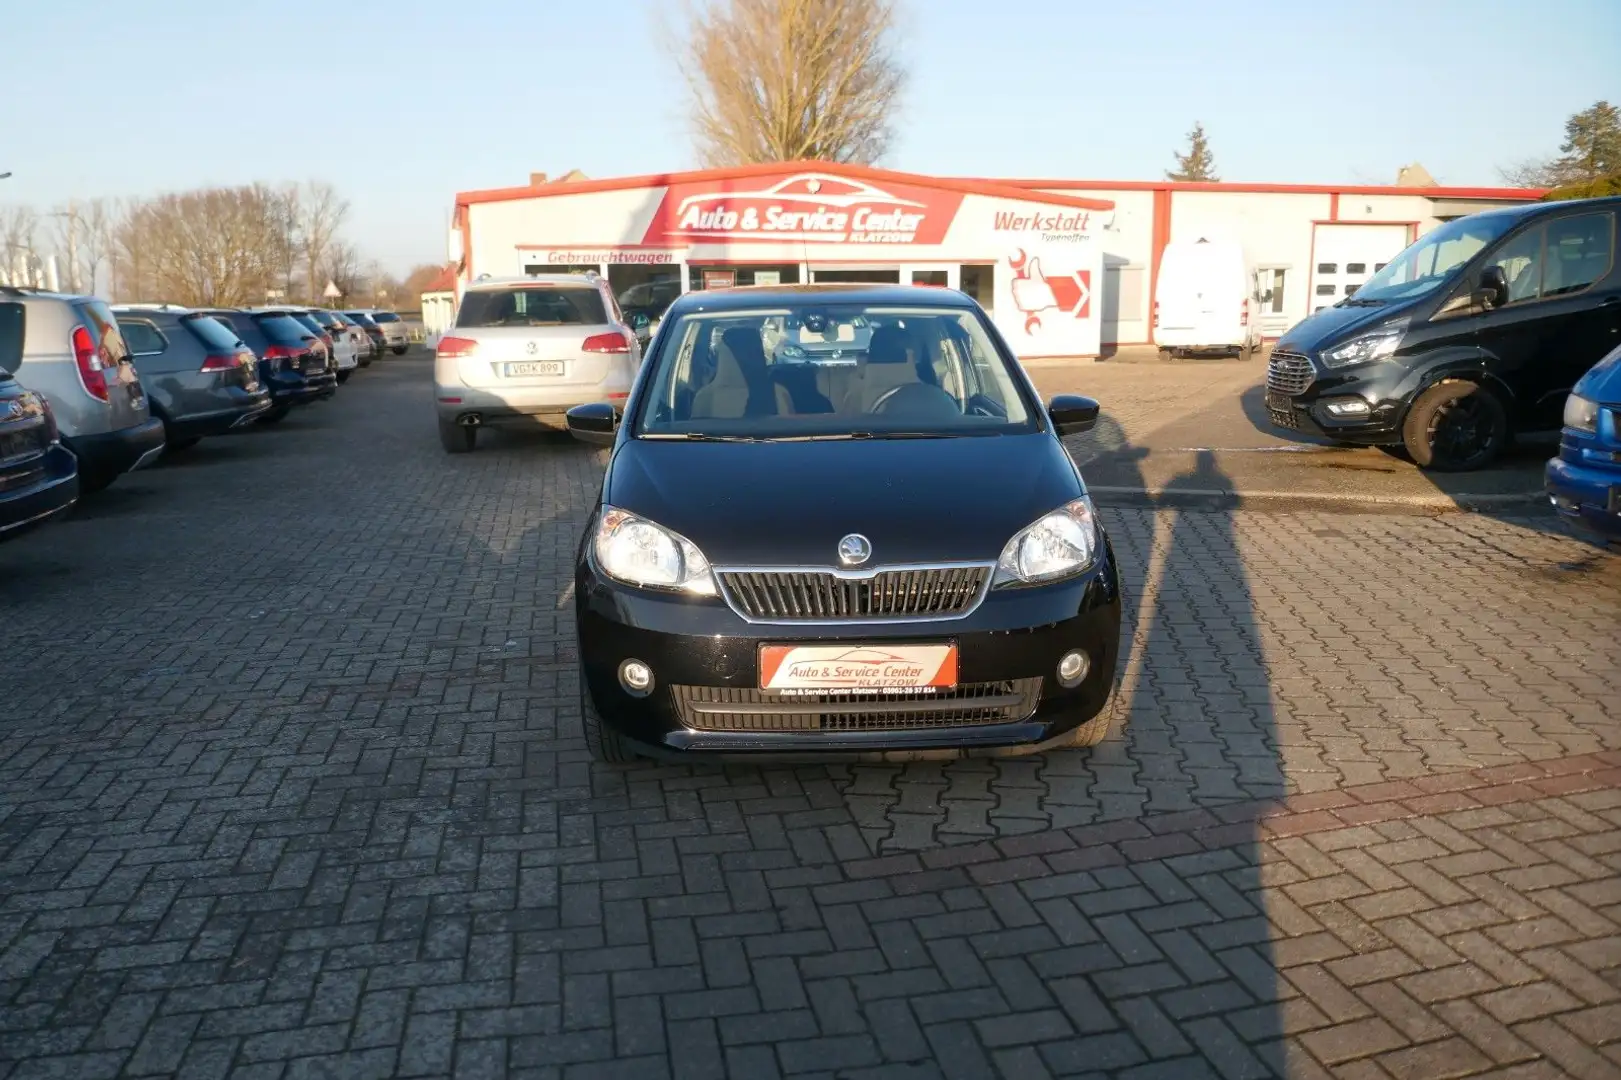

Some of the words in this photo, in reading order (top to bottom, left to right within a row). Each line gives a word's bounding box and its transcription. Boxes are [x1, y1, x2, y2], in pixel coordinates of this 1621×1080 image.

[679, 206, 738, 229] Auto
[740, 207, 758, 230] &
[763, 207, 848, 231] Service
[851, 207, 926, 232] Center
[994, 212, 1089, 231] Werkstatt
[1041, 232, 1090, 243] Typenoffen
[547, 251, 673, 265] Gebrauchtwagen
[788, 666, 819, 678] Auto
[821, 666, 830, 677] &
[833, 665, 880, 678] Service
[883, 665, 924, 678] Center
[780, 688, 797, 696] Auto
[804, 688, 829, 696] Service
[828, 688, 852, 696] Center
